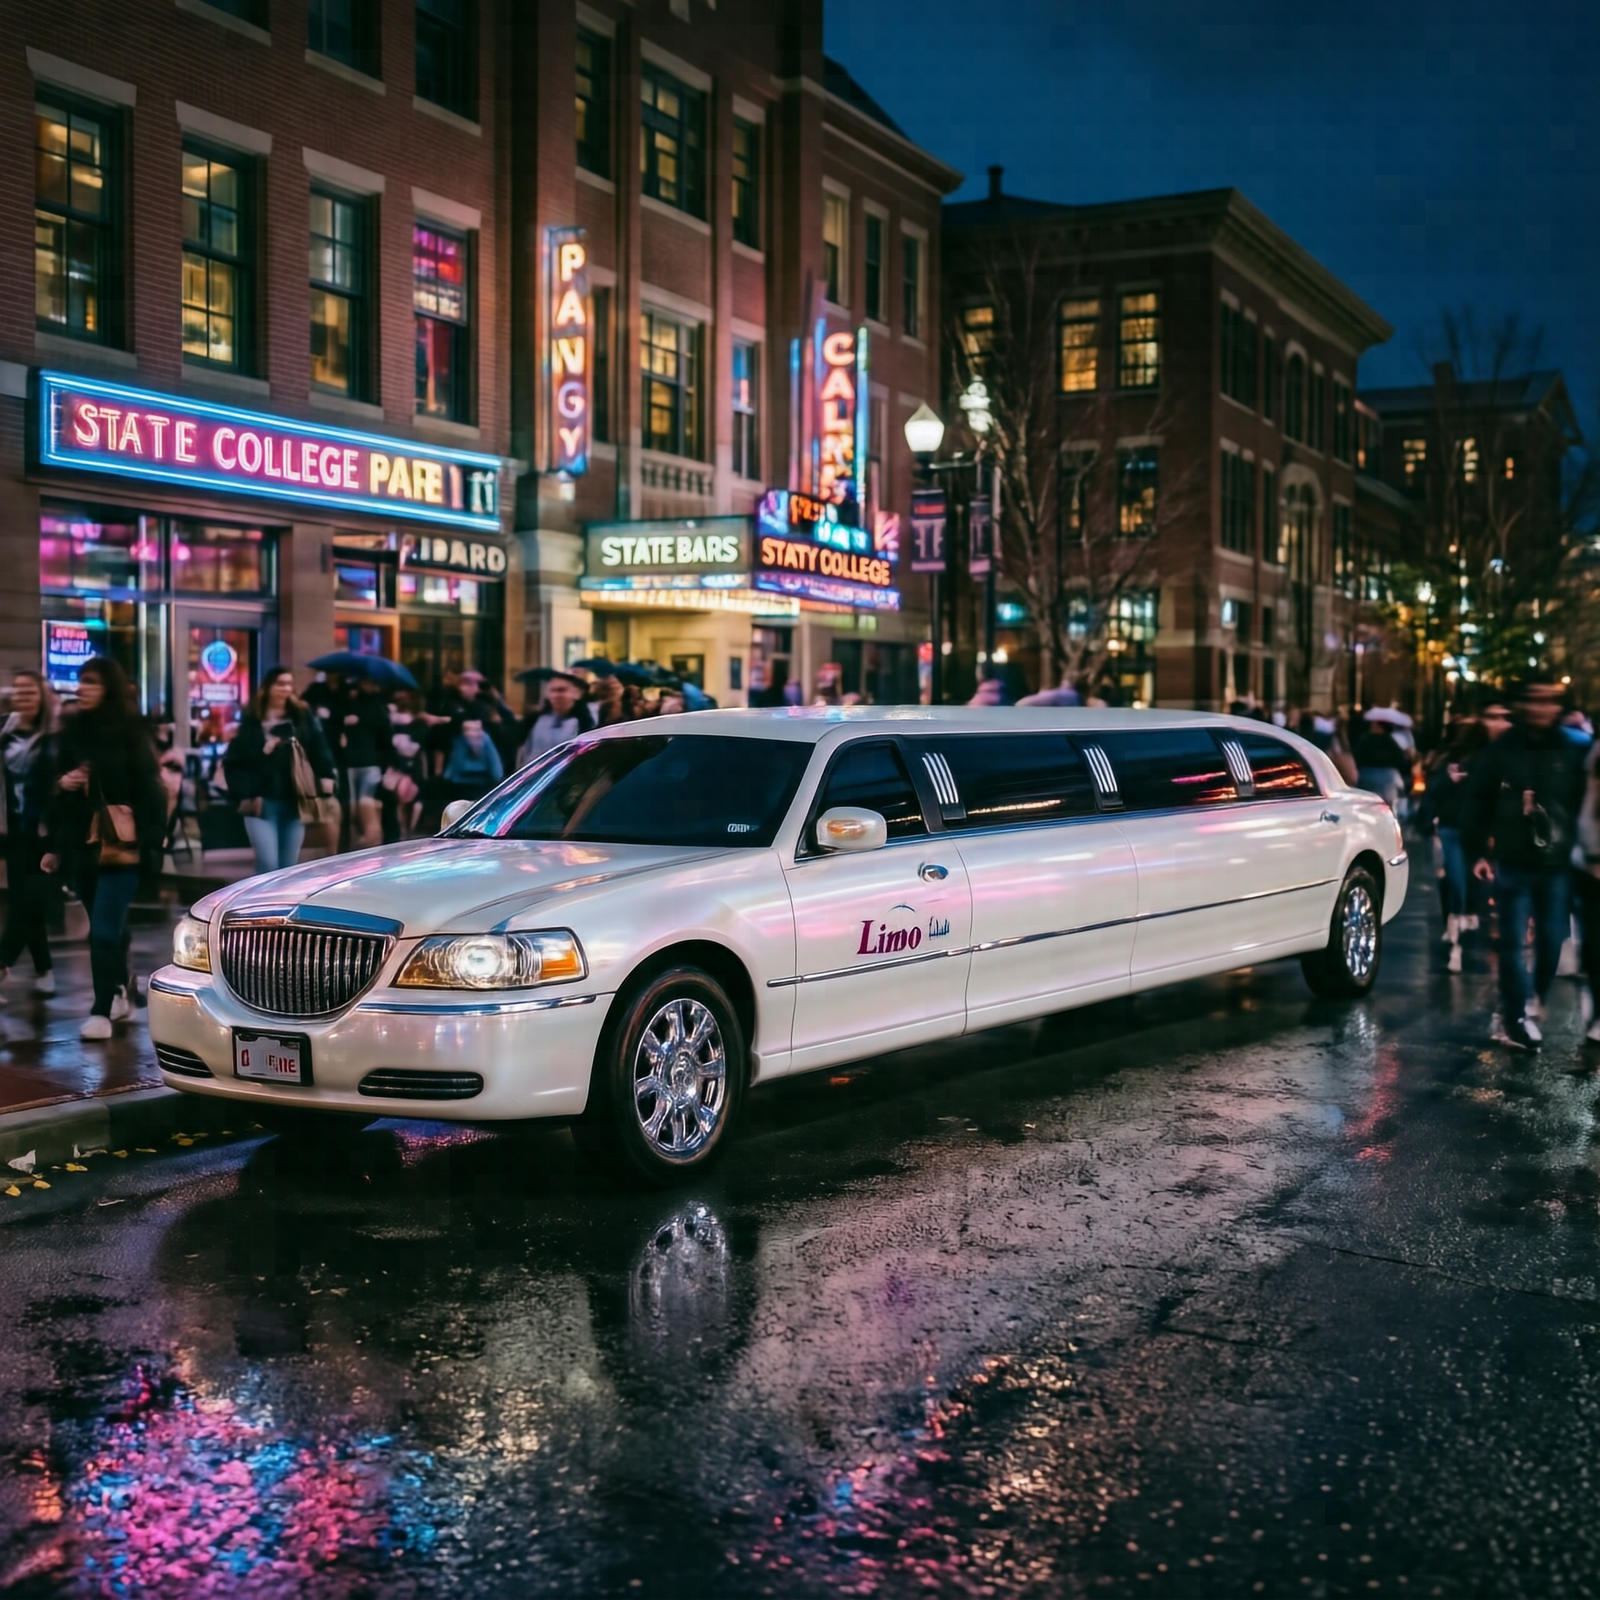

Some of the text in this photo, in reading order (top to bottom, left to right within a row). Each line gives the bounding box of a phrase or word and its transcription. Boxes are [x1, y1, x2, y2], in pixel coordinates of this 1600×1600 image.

[74, 403, 197, 463] STATE
[212, 427, 359, 489] COLLEGE
[601, 535, 738, 566] STATE BARS
[762, 537, 890, 585] STATY COLLEGE
[857, 919, 922, 954] Limo
